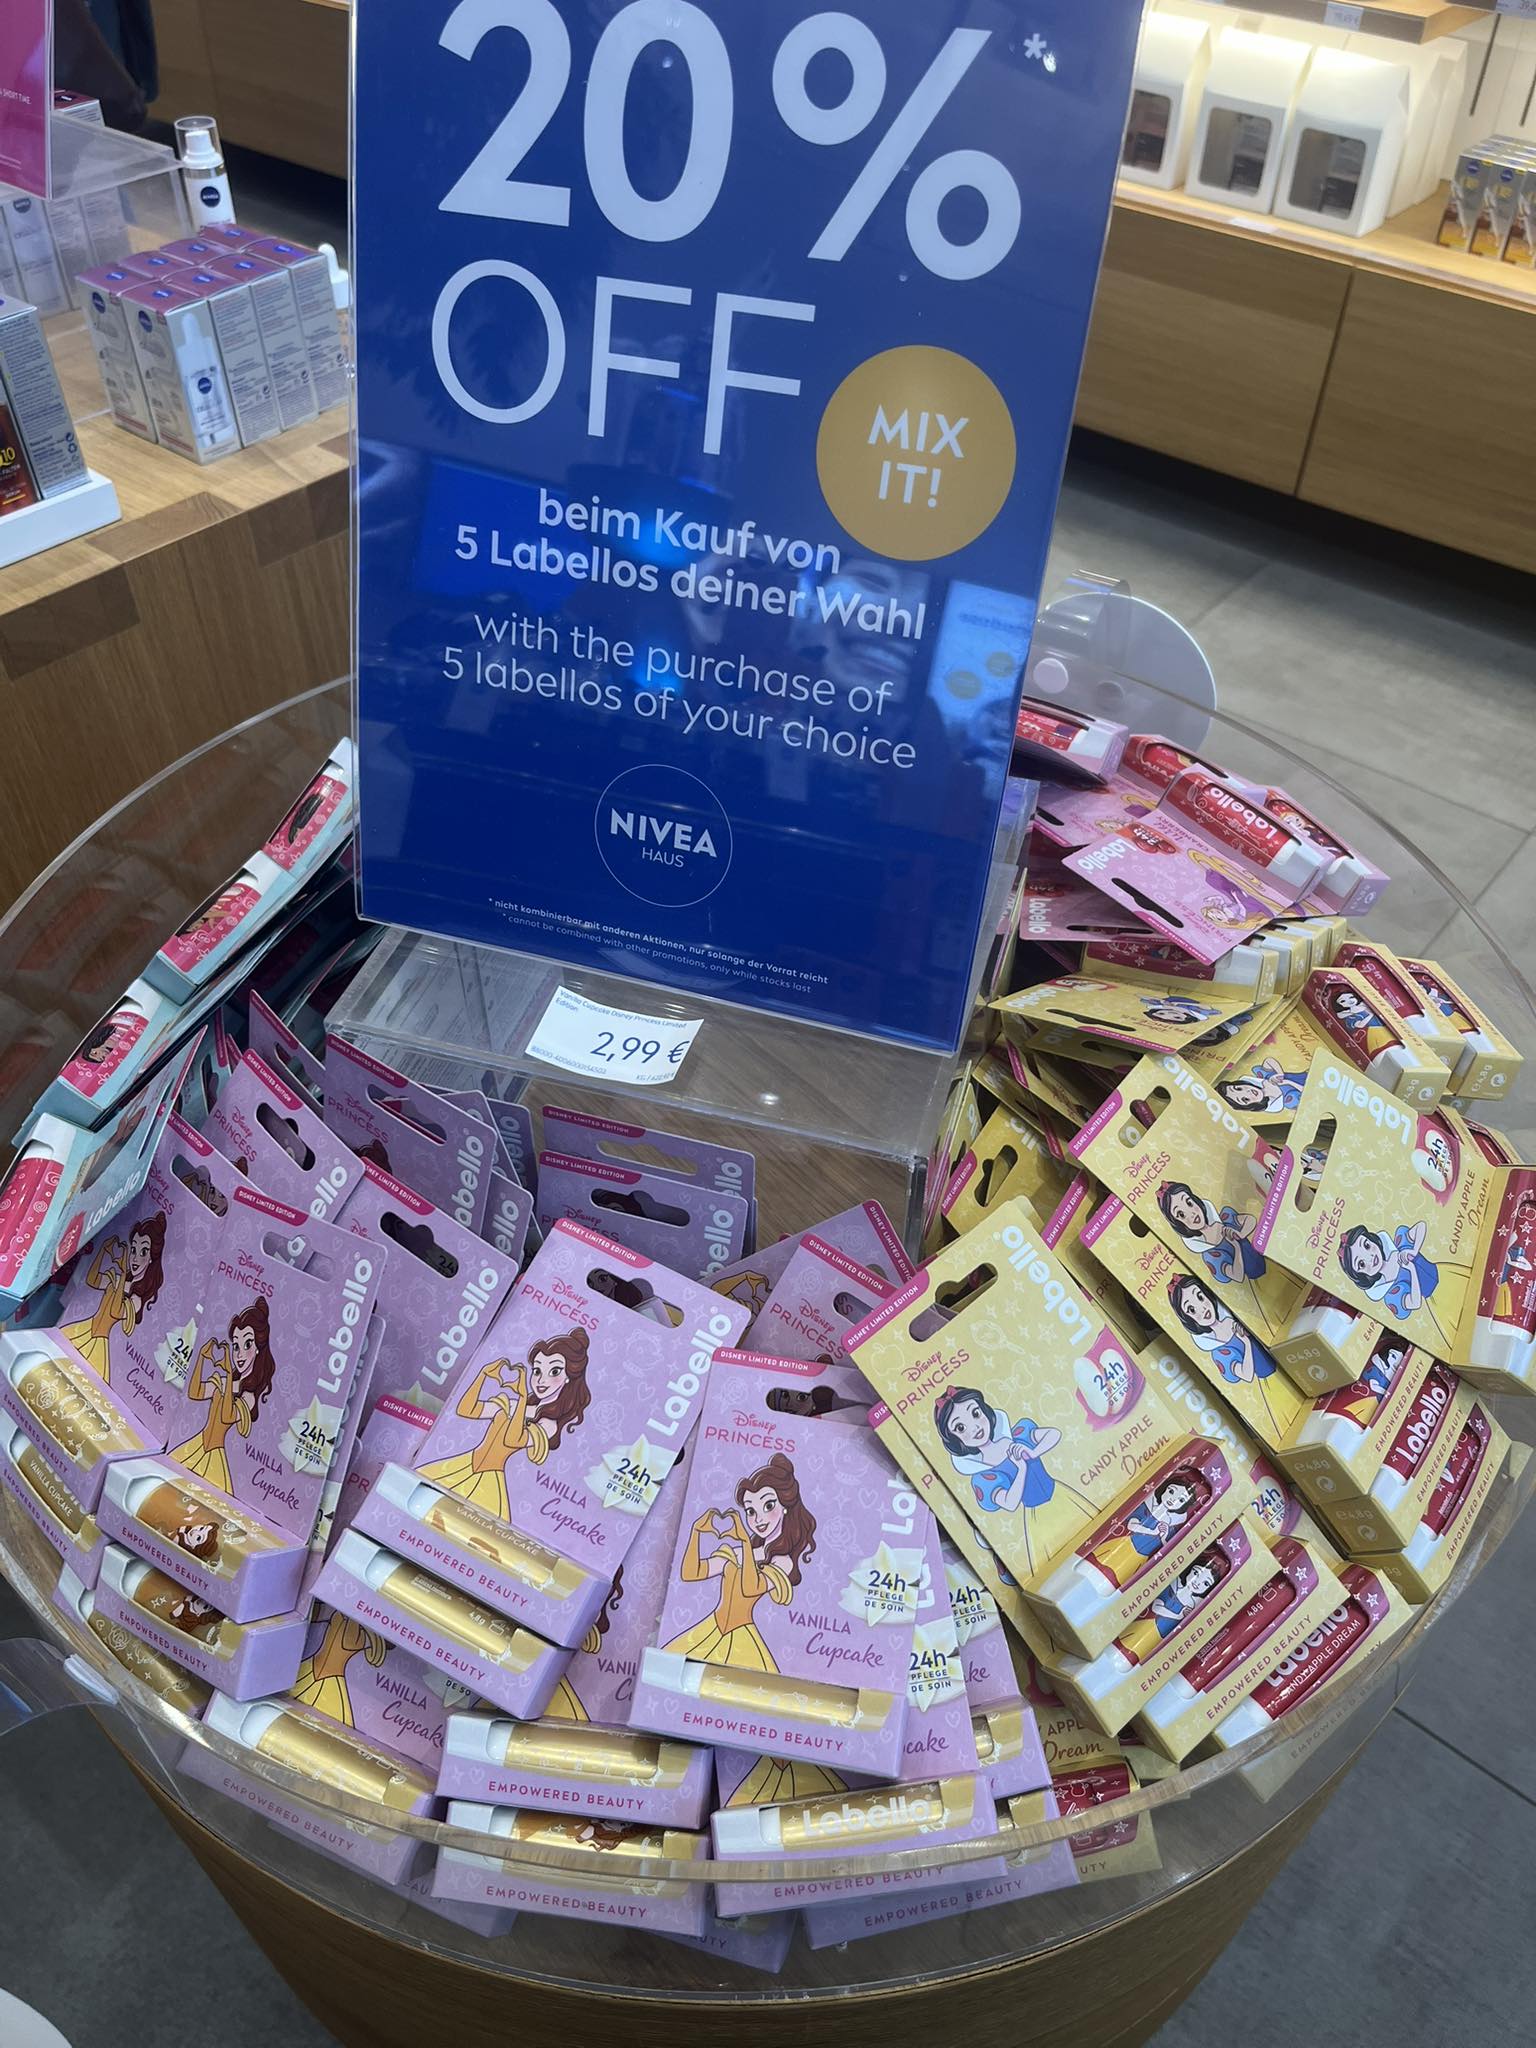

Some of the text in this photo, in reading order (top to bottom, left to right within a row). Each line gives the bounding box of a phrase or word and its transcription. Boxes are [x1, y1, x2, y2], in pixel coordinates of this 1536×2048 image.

[432, 259, 815, 455] OFF
[868, 405, 969, 459] MIX
[878, 463, 941, 508] IT!
[539, 488, 840, 573] beim Kauf von
[455, 525, 925, 640] 5 Labellos deiner Wahl
[474, 612, 893, 715] with the purchase of
[443, 647, 916, 768] 5 labellos of your choice
[610, 808, 717, 857] NIVEA
[1209, 787, 1278, 840] Labello
[642, 847, 684, 868] HAUS
[1077, 838, 1137, 870] Labello
[1029, 898, 1053, 934] Labello
[495, 900, 828, 984] nicht kombinierbar mit anderen Aktionen, nur solange der Vorrat reicht
[508, 916, 811, 993] cannot be combined with other promotions, only while stocks last
[556, 999, 578, 1012] Edition
[611, 1010, 633, 1020] Disney
[635, 1015, 661, 1025] Princess
[590, 1031, 660, 1064] 2,99
[667, 1041, 690, 1063] €
[328, 1096, 389, 1144] PRINCESS
[1163, 1055, 1250, 1150] Labello
[1323, 1067, 1412, 1146] Labello
[213, 1109, 257, 1162] PRINCESS
[545, 1156, 625, 1179] DISNEY LIMITED EDITION
[1123, 1152, 1151, 1179] Disney
[1127, 1151, 1172, 1205] PRINCESS
[83, 1169, 142, 1235] Labello
[1257, 1165, 1288, 1246] DISNEY LIMITED EDITION
[1449, 1169, 1476, 1255] CANDY APPLE
[1468, 1178, 1489, 1229] Dream
[562, 1221, 637, 1262] DISNEY LIMITED EDITION
[1306, 1211, 1329, 1249] Disney
[1313, 1197, 1345, 1280] PRINCESS
[218, 1260, 274, 1298] PRINCESS
[238, 1249, 265, 1276] Disney
[809, 1240, 884, 1290] DISNEY LIMITED EDITION
[1002, 1225, 1092, 1346] Labello
[521, 1284, 600, 1331] PRINCESS
[552, 1277, 590, 1308] Disney
[848, 1286, 919, 1345] DISNEY LIMITED EDITION
[317, 1258, 373, 1394] Labello
[421, 1267, 499, 1386] Labello
[770, 1303, 845, 1362] PRINCESS
[647, 1313, 733, 1437] Labello
[720, 1351, 809, 1371] DISNEY LIMITED EDITION
[896, 1348, 971, 1415] PRINCESS
[901, 1350, 944, 1384] Disney
[1093, 1361, 1125, 1391] 24h
[127, 1368, 164, 1416] Cupcake
[383, 1400, 434, 1426] DISNEY LIMITED
[1375, 1361, 1424, 1452] EMPOWERED BEAUTY
[299, 1421, 326, 1446] 24h
[705, 1426, 796, 1453] PRINCESS
[732, 1410, 777, 1434] Disney
[1395, 1385, 1447, 1465] Labello
[245, 1443, 283, 1476] VANILLA
[615, 1458, 652, 1485] 24h
[1080, 1415, 1153, 1487] CANDY APPLE
[1120, 1432, 1170, 1481] Dream
[1416, 1408, 1465, 1502] EMPOWERED BEAUTY
[30, 1459, 73, 1518] VANILLA CUPCAKE
[252, 1469, 300, 1511] Cupcake
[535, 1470, 587, 1509] VANILLA
[606, 1482, 641, 1504] DE SOIN
[613, 1473, 646, 1495] PFLEGE
[455, 1506, 541, 1557] VANILLA CUPCAKE
[539, 1498, 606, 1547] Cupcake
[122, 1526, 209, 1592] EMPOWERED BEAUTY
[399, 1530, 529, 1609] EMPOWERED BEAUTY
[868, 1569, 906, 1592] 24h
[1120, 1515, 1225, 1619] EMPOWERED BEAUTY
[864, 1600, 904, 1613] DE SOIN
[867, 1589, 904, 1601] PFLEGE
[1247, 1602, 1263, 1617] 4,8g
[120, 1611, 208, 1672] EMPOWERED BEAUTY
[356, 1601, 487, 1682] EMPOWERED BEAUTY
[788, 1610, 851, 1635] VANILLA
[1140, 1586, 1244, 1692] EMPOWERED BEAUTY
[806, 1632, 885, 1667] Cupcake
[908, 1650, 946, 1670] 24h
[1206, 1615, 1312, 1720] EMPOWERED BEAUTY
[1283, 1619, 1360, 1698] ANDY APPLE DREAM
[376, 1672, 428, 1711] VANILLA
[911, 1669, 948, 1679] PFLEGE
[911, 1680, 951, 1693] DE SOIN
[683, 1712, 844, 1751] EMPOWERED BEAUTY
[1044, 1740, 1104, 1763] Dream
[223, 1778, 354, 1852] EMPOWERED BEAUTY
[488, 1781, 644, 1810] EMPOWERED BEAUTY
[803, 1795, 932, 1837] Labello
[486, 1885, 648, 1918] EMPOWERED BEAUTY
[864, 1879, 1024, 1927] EMPOWERED BEAUTY
